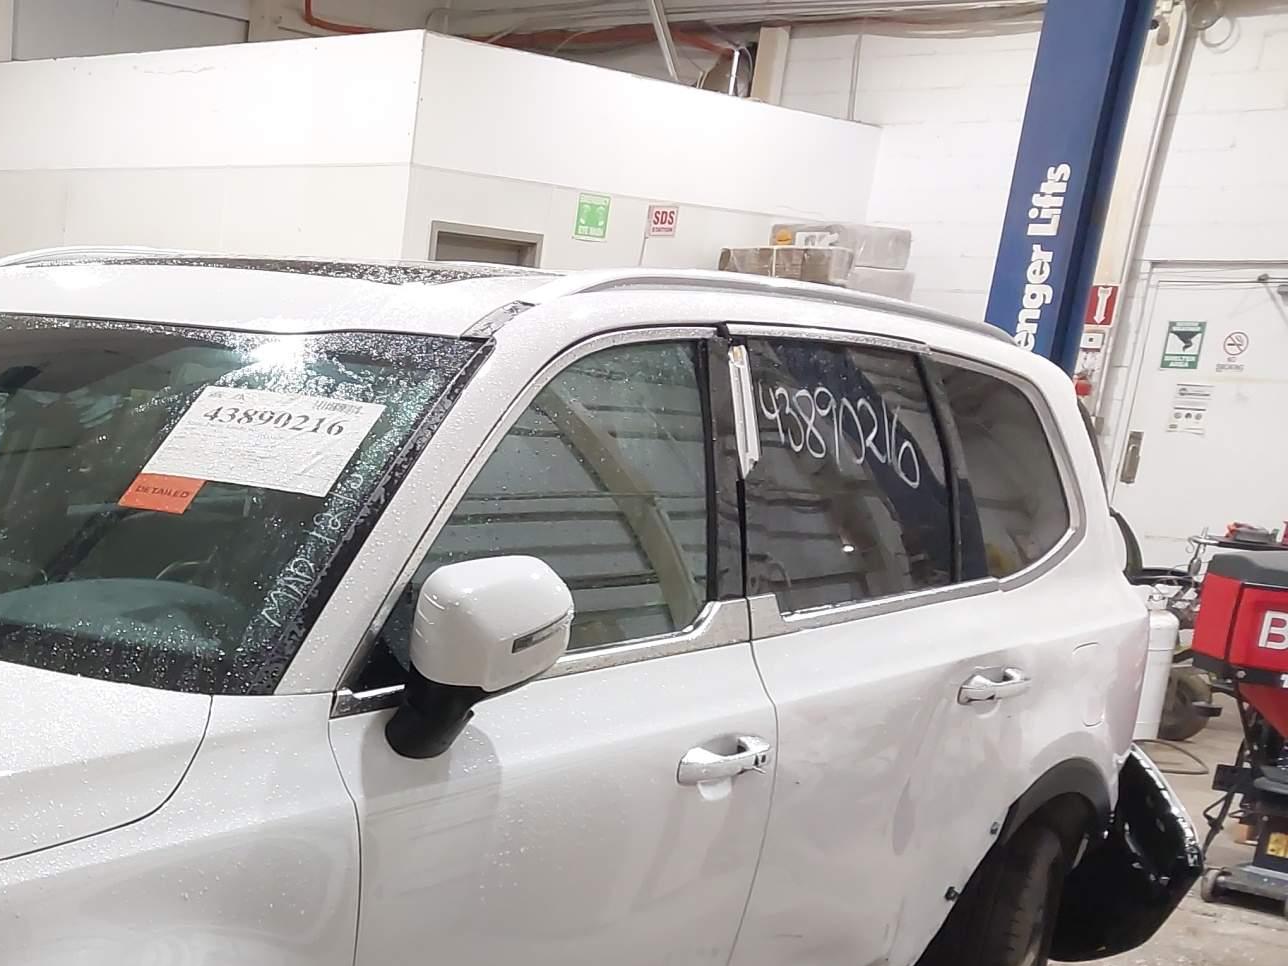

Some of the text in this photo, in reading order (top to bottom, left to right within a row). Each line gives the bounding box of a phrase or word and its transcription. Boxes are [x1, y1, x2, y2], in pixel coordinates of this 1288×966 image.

[1027, 163, 1071, 236] Lifts
[653, 210, 675, 225] SDS
[204, 406, 345, 436] 43890216
[758, 377, 921, 489] 43890216
[135, 485, 191, 498] DETAILED
